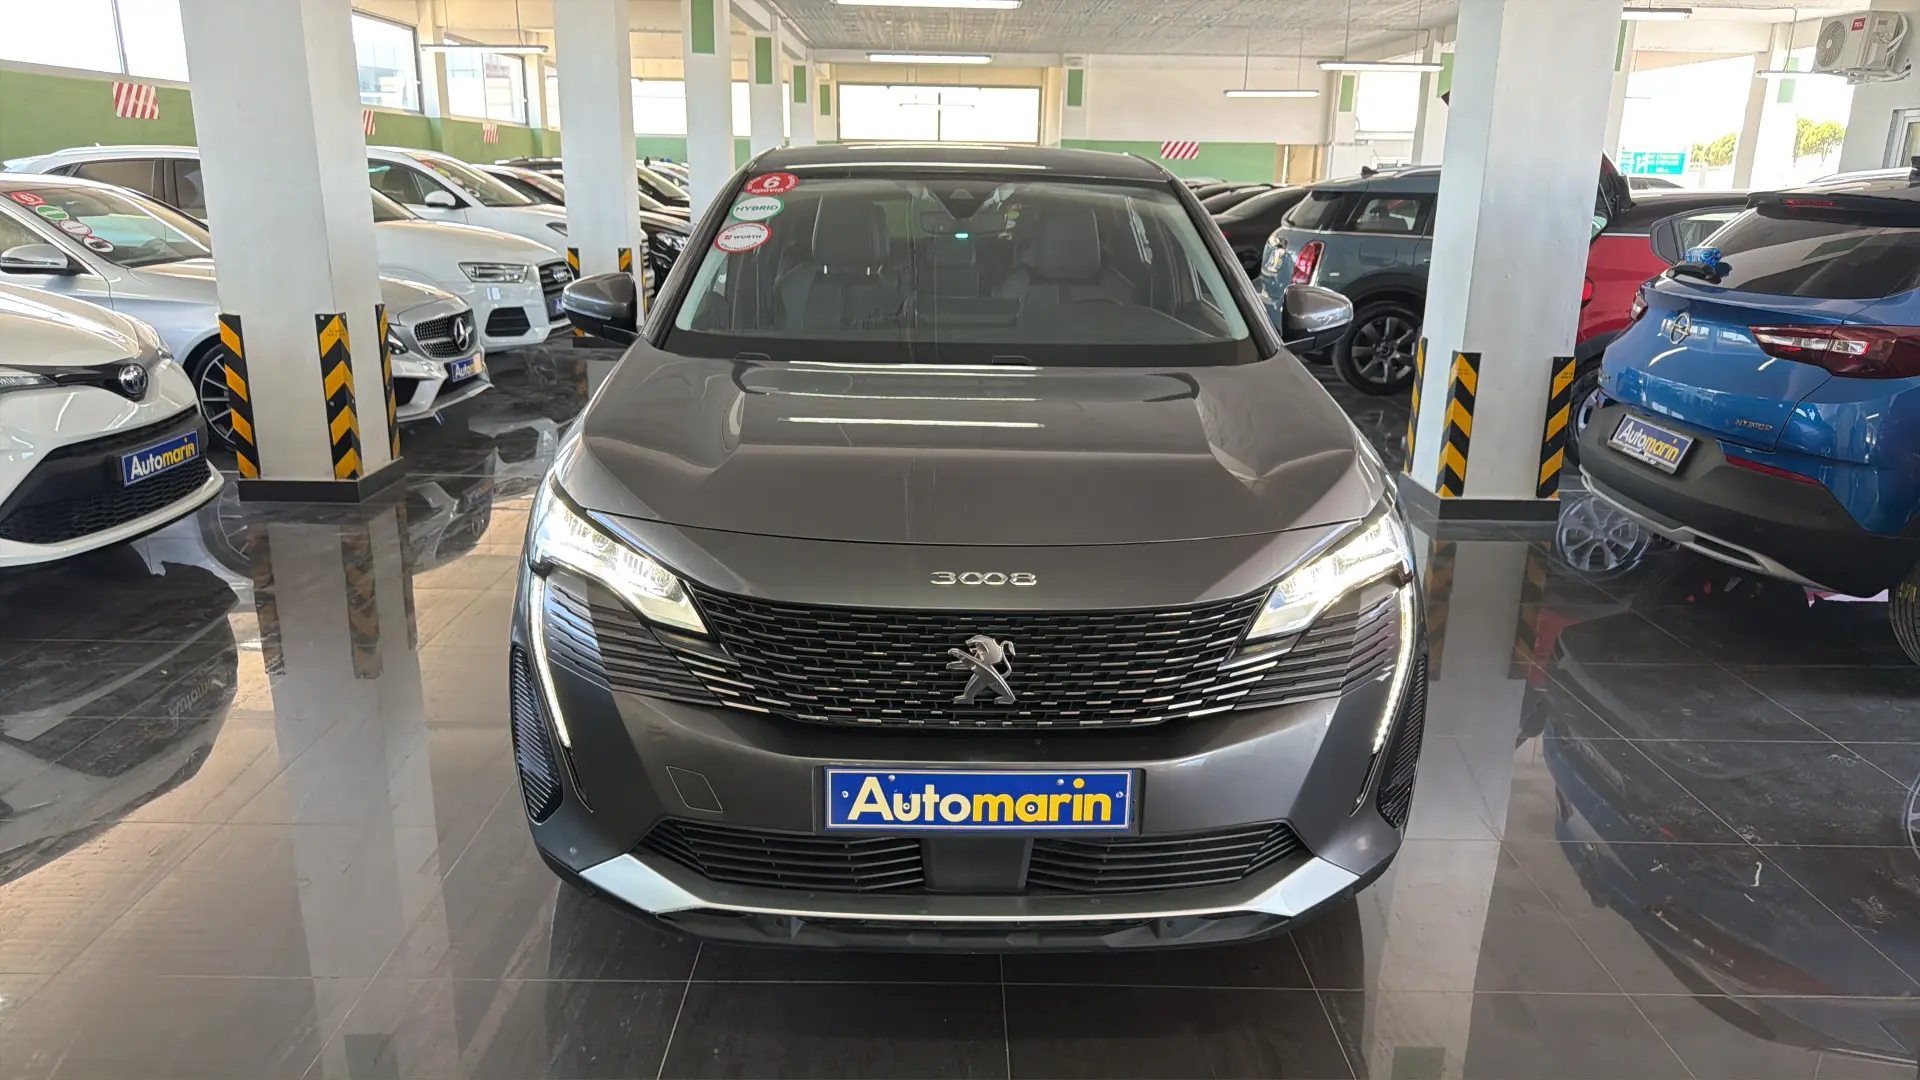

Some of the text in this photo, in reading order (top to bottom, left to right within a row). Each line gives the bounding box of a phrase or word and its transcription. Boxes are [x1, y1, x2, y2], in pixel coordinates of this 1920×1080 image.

[763, 175, 782, 188] 6
[735, 204, 779, 212] HYBRID
[1618, 420, 1680, 462] Automarin
[130, 436, 196, 480] Automarin
[930, 571, 1037, 586] 3008
[847, 776, 1112, 823] Automarin
